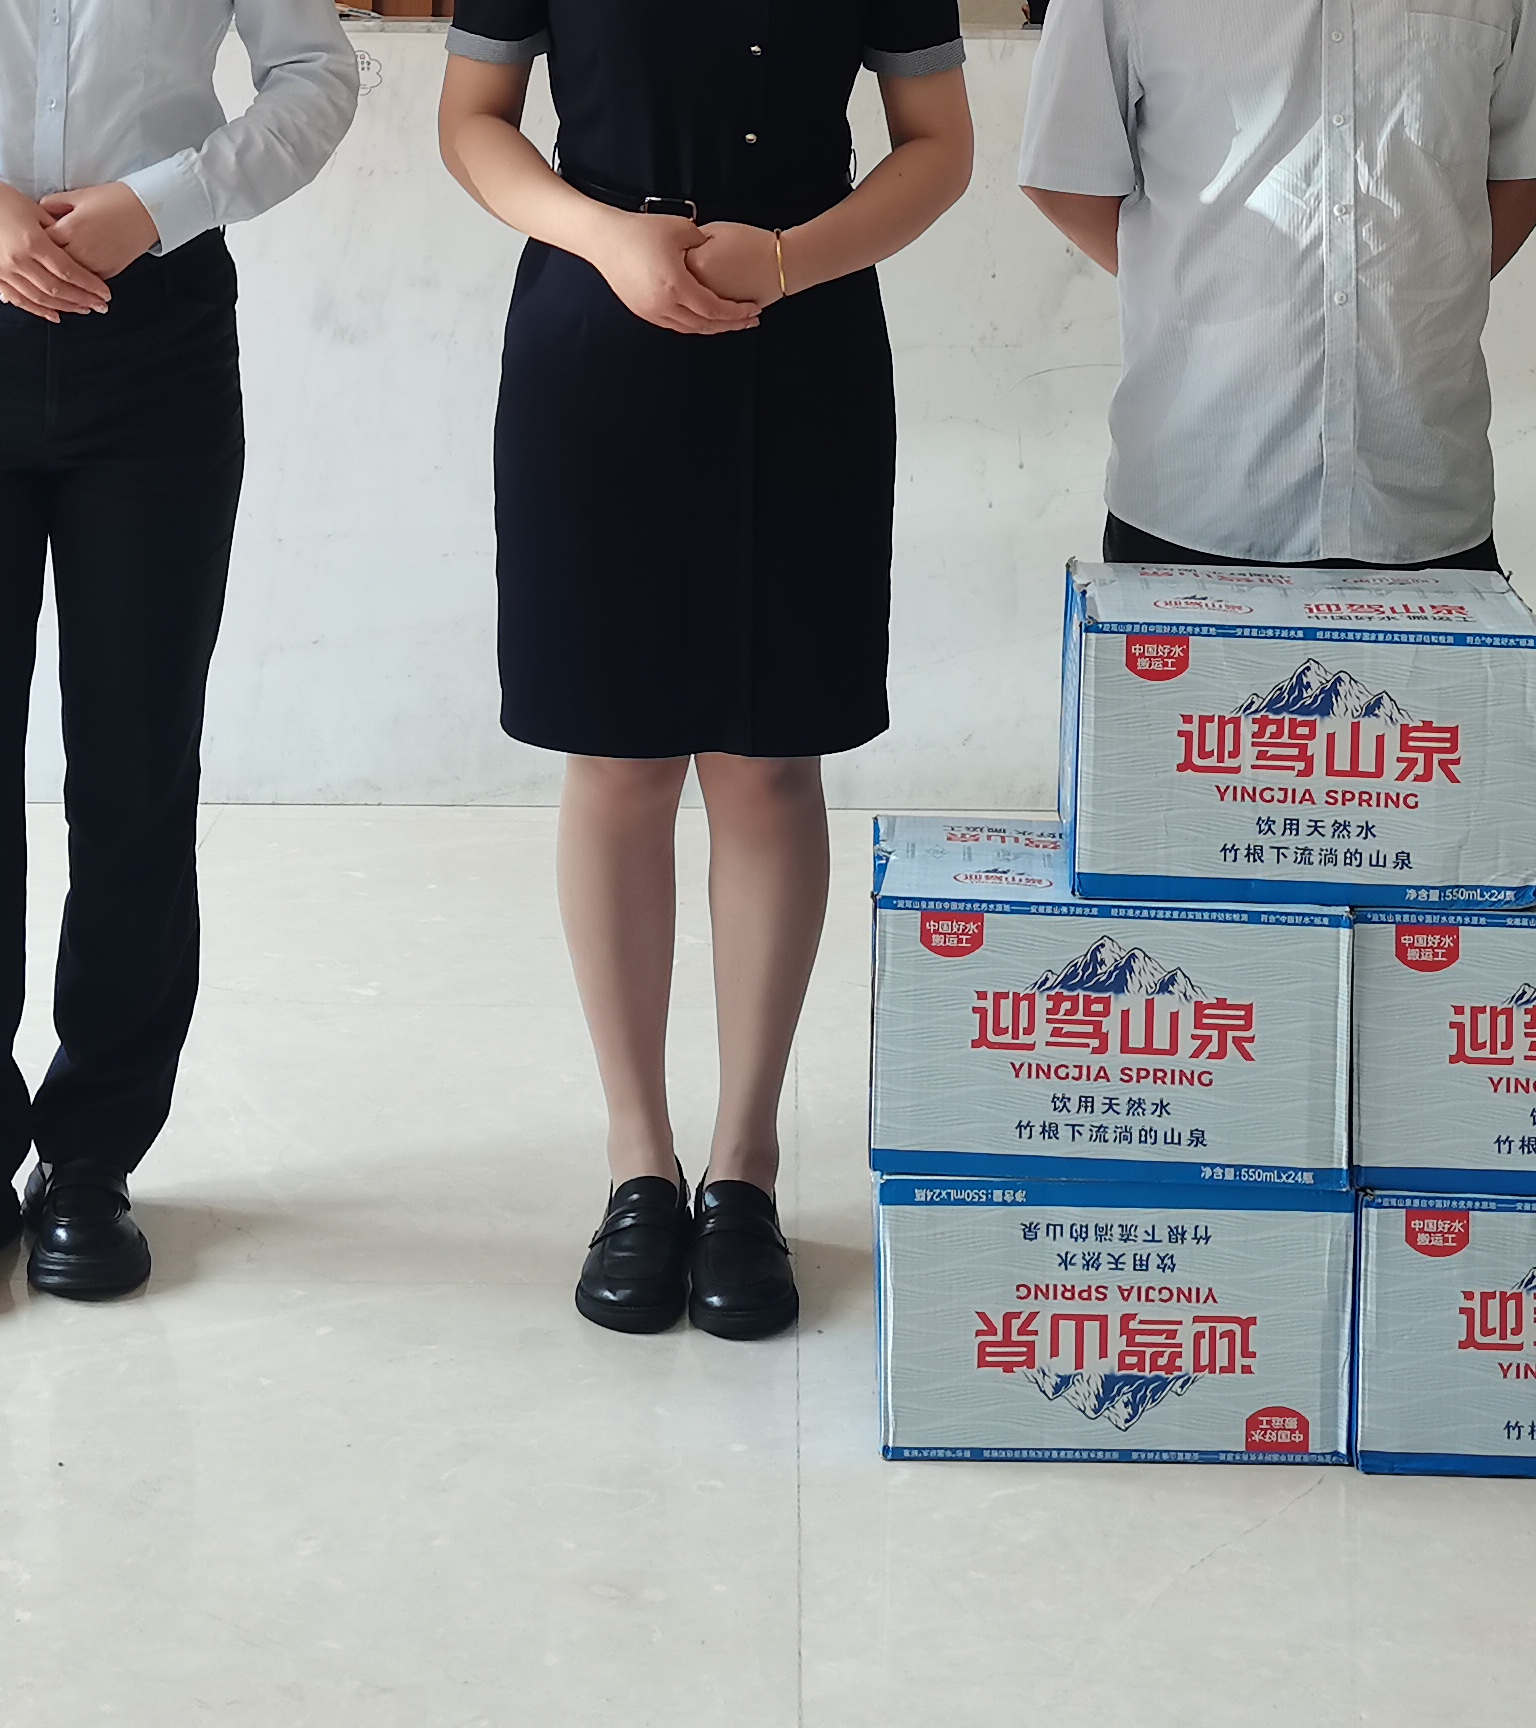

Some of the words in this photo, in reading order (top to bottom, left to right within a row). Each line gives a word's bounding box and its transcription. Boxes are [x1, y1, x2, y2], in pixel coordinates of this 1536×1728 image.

[1177, 715, 1460, 783] 迎驾山泉
[1216, 786, 1316, 805] YINGJIA
[1325, 790, 1418, 809] SPRING
[1256, 816, 1376, 840] 饮用天然水
[1220, 843, 1413, 870] 竹根下流淌的山泉
[972, 991, 1255, 1061] 迎驾山泉
[1012, 1063, 1110, 1082] YINGJIA
[1121, 1068, 1212, 1086] SPRING
[1051, 1093, 1171, 1117] 饮用天然水
[1015, 1120, 1207, 1147] 竹根下流淌的山泉
[1020, 1222, 1211, 1245] 竹根下流淌的山泉
[1057, 1251, 1176, 1273] 饮用天然水
[1016, 1284, 1108, 1301] SPRING
[1118, 1286, 1217, 1303] YINGJIA
[976, 1312, 1257, 1375] 迎驾山泉
